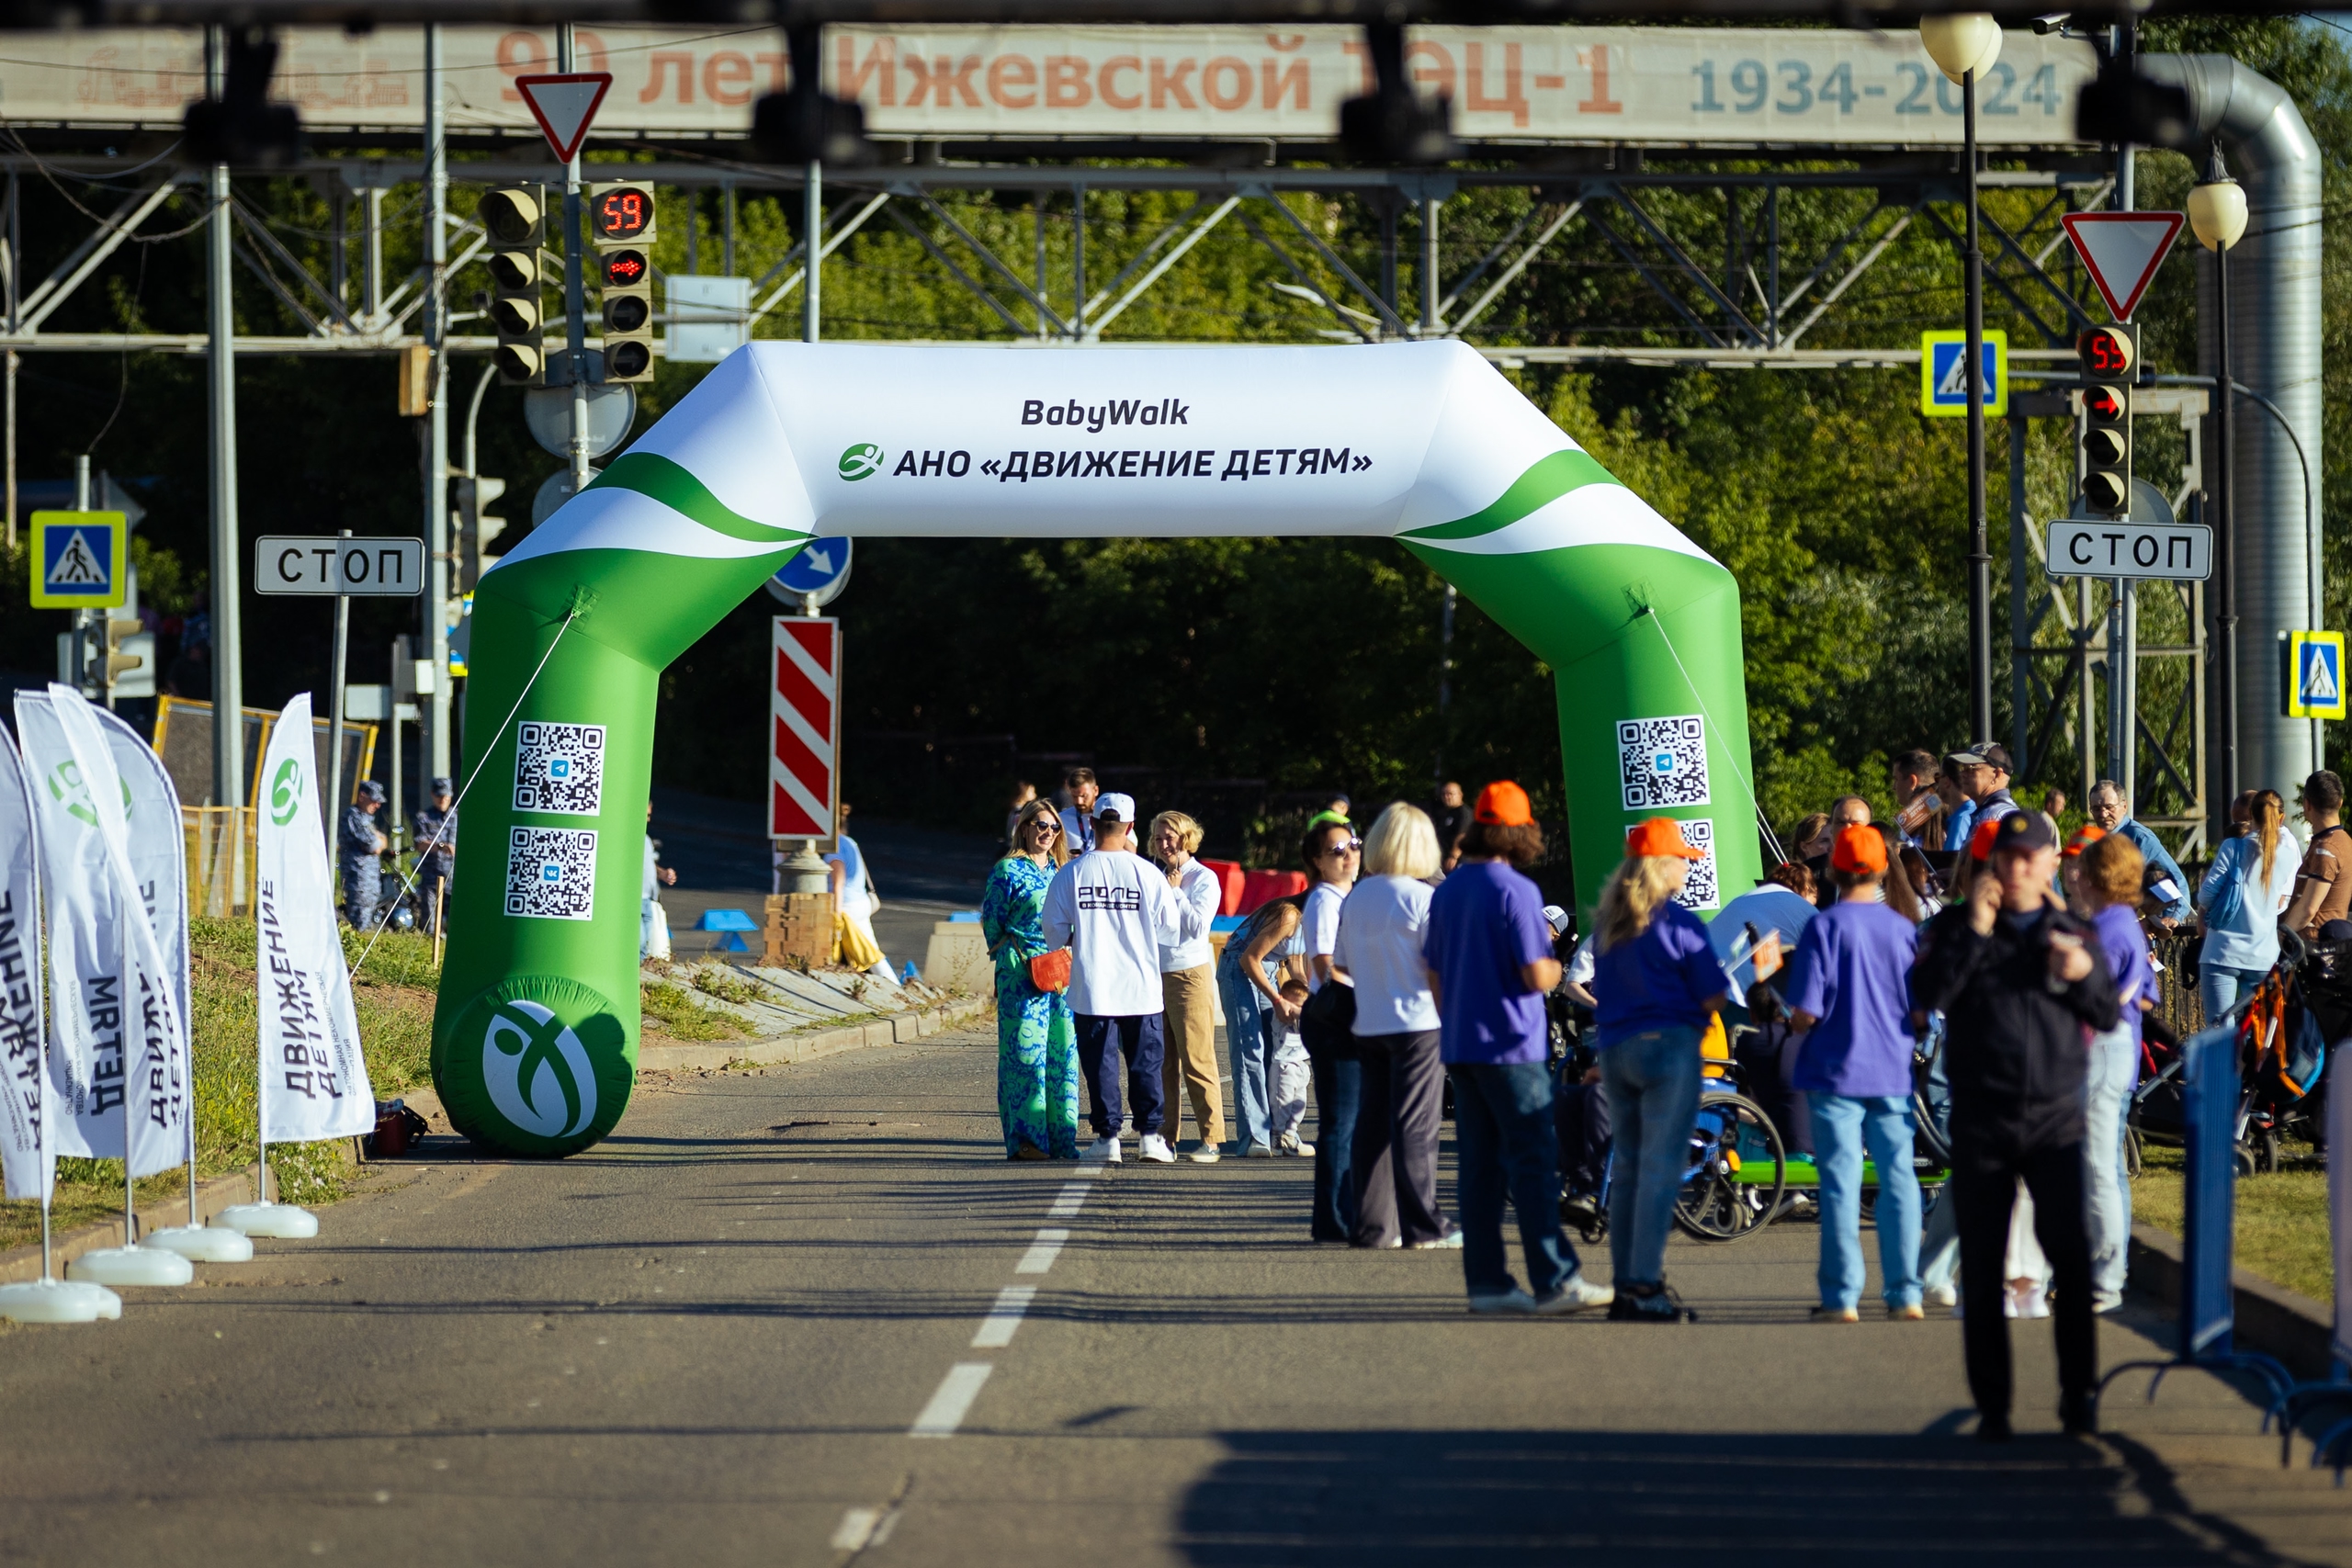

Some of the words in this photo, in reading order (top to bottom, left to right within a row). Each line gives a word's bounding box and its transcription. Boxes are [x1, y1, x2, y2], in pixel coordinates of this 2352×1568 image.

[837, 34, 1312, 111] Ижевской
[603, 194, 641, 231] 59
[1021, 398, 1191, 434] BabyWalk
[893, 449, 972, 478] АНО
[979, 449, 1216, 483] «ДВИЖЕНИЕ
[1220, 447, 1374, 482] ДЕТЯМ»
[277, 547, 402, 584] СТОП
[2069, 532, 2193, 569] СТОП
[262, 875, 317, 1100] ДВИЖЕНИЕ
